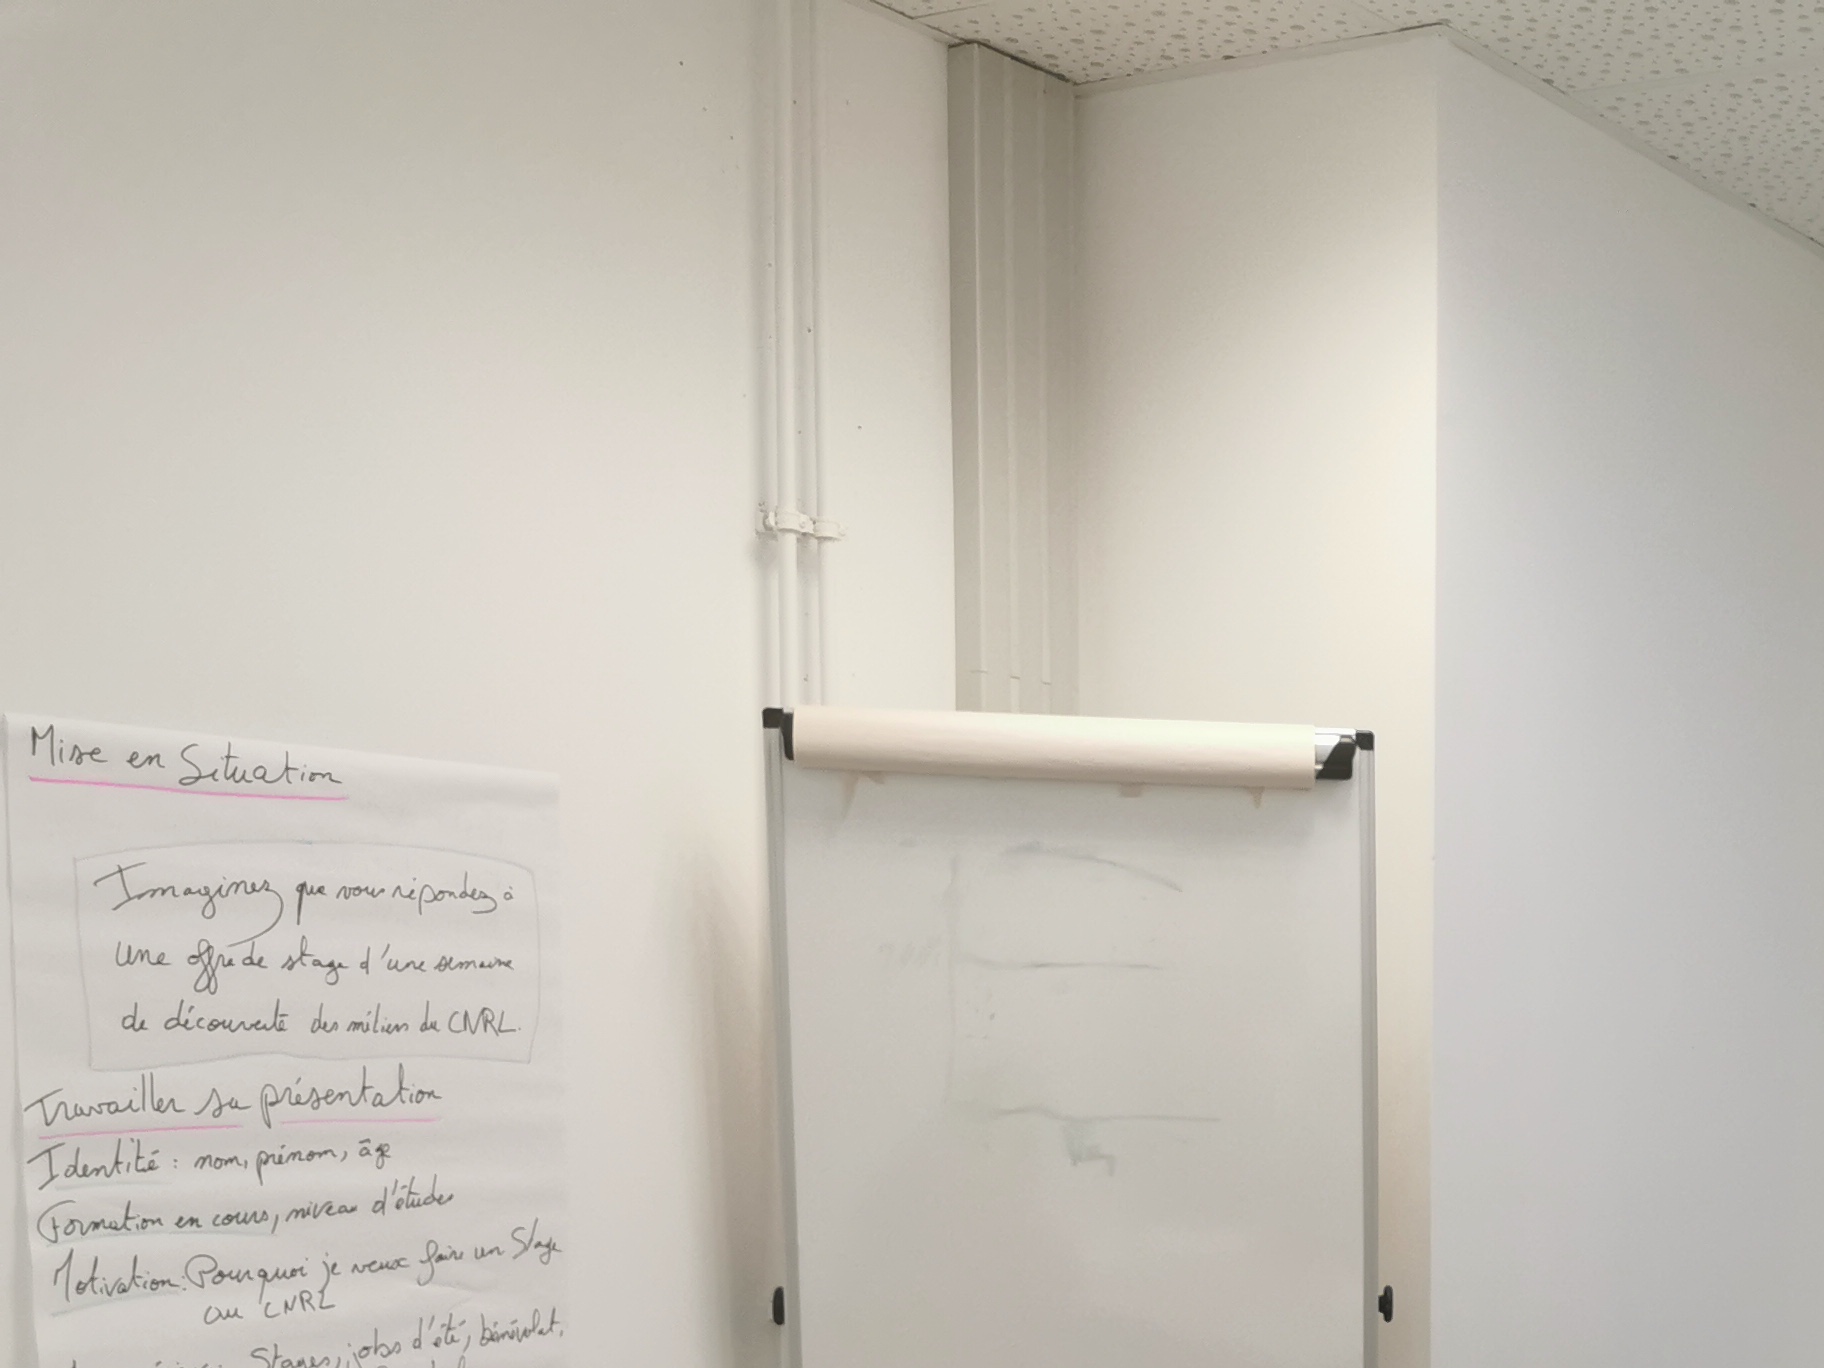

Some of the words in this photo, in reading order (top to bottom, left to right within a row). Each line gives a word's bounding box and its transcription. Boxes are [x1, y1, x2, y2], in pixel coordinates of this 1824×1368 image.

[31, 724, 107, 766] Mise
[127, 749, 165, 768] en
[178, 741, 342, 786] Situation
[93, 861, 284, 948] Imaginez
[296, 880, 327, 926] que
[336, 885, 385, 900] vous
[241, 940, 268, 969] de
[281, 935, 349, 986] stage
[360, 943, 427, 975] d'une
[433, 955, 515, 973] semaine
[122, 1001, 148, 1032] de
[164, 999, 289, 1033] découverte
[310, 1002, 338, 1034] des
[23, 1071, 186, 1127] Travailler
[194, 1087, 251, 1119] sa
[261, 1062, 443, 1129] présentation
[358, 1138, 391, 1169] âge
[36, 1200, 163, 1244] Formation
[174, 1213, 203, 1228] en
[185, 1254, 308, 1304] Pourquoi
[321, 1252, 341, 1291] je
[351, 1257, 410, 1274] veux
[416, 1239, 464, 1287] faire
[474, 1245, 505, 1261] un
